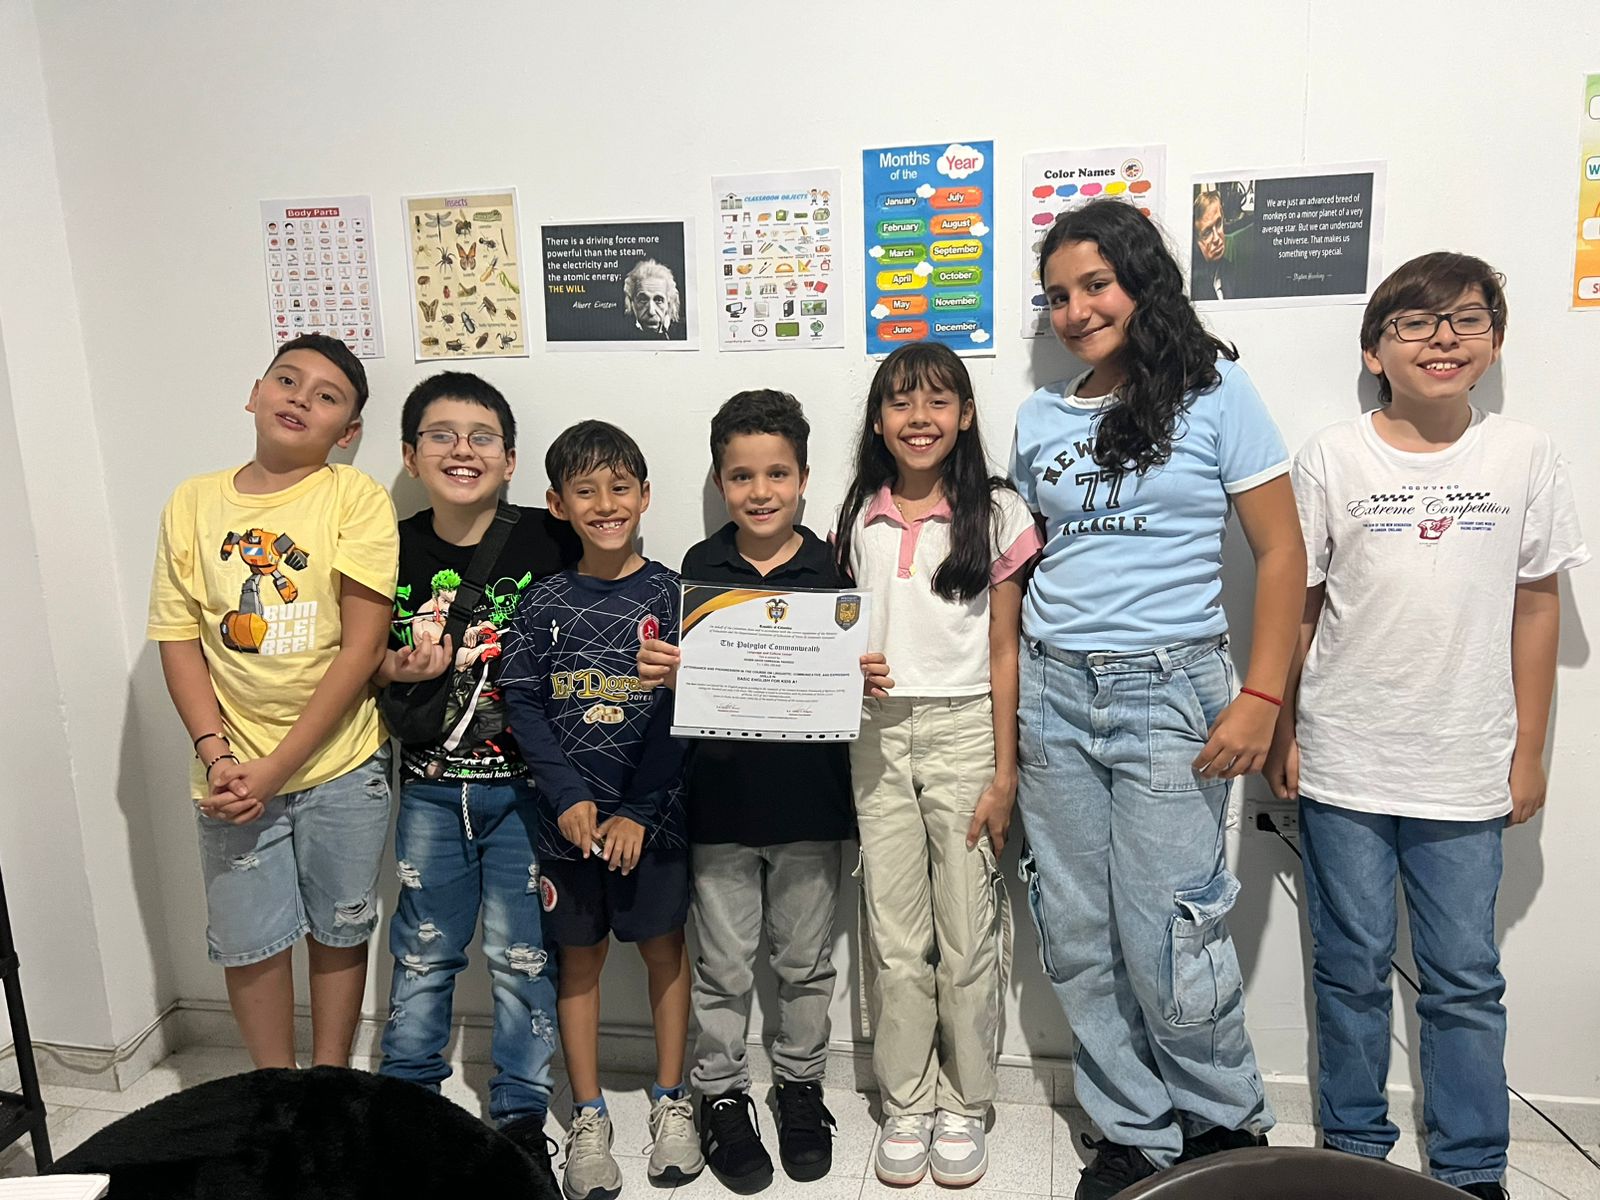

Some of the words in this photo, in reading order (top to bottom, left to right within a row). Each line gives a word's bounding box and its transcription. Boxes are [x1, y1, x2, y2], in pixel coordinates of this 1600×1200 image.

[880, 152, 930, 168] Months
[946, 156, 978, 170] Year
[890, 170, 899, 180] of
[902, 169, 917, 179] the
[1044, 170, 1075, 179] Color
[1079, 168, 1116, 177] Names
[445, 199, 468, 207] Insects
[744, 194, 780, 202] CLASSROOM
[885, 197, 916, 206] January
[947, 193, 965, 203] July
[1267, 199, 1276, 207] We
[1287, 198, 1298, 208] just
[1307, 196, 1334, 205] advanced
[1336, 194, 1352, 203] breed
[1354, 193, 1360, 202] of
[288, 209, 312, 217] Body
[314, 208, 338, 216] Parts
[1263, 212, 1287, 222] monkeys
[1302, 210, 1318, 218] minor
[1319, 209, 1337, 219] planet
[1339, 208, 1345, 216] of
[1350, 208, 1363, 217] very
[883, 223, 919, 232] February
[942, 219, 971, 229] August
[1262, 226, 1284, 235] average
[1299, 223, 1308, 232] But
[1330, 220, 1363, 230] understand
[546, 237, 568, 246] There
[571, 237, 577, 245] is
[586, 236, 614, 246] driving
[616, 235, 636, 244] force
[638, 236, 659, 244] more
[1273, 238, 1282, 246] the
[1284, 237, 1309, 245] Universe.
[1311, 235, 1323, 244] That
[1324, 235, 1342, 243] makes
[547, 249, 582, 259] powerful
[584, 249, 602, 257] than
[620, 249, 646, 257] steam,
[889, 249, 914, 258] March
[934, 245, 978, 256] September
[1279, 249, 1308, 259] something
[1309, 250, 1321, 258] very
[1322, 248, 1342, 258] special.
[563, 261, 601, 270] electricity
[604, 260, 619, 268] and
[563, 273, 590, 281] atomic
[592, 274, 622, 282] energy:
[892, 274, 912, 285] April
[940, 271, 972, 281] October
[566, 285, 586, 293] WILL
[894, 301, 910, 310] May
[935, 298, 976, 306] November
[893, 326, 912, 334] June
[935, 323, 976, 332] December
[1042, 437, 1093, 485] NEW
[1075, 470, 1124, 512] 77
[1347, 500, 1416, 518] Extreme
[1422, 497, 1511, 519] Competition
[737, 641, 767, 650] Polyglot
[769, 643, 820, 652] Commonwealth
[551, 671, 575, 700] El
